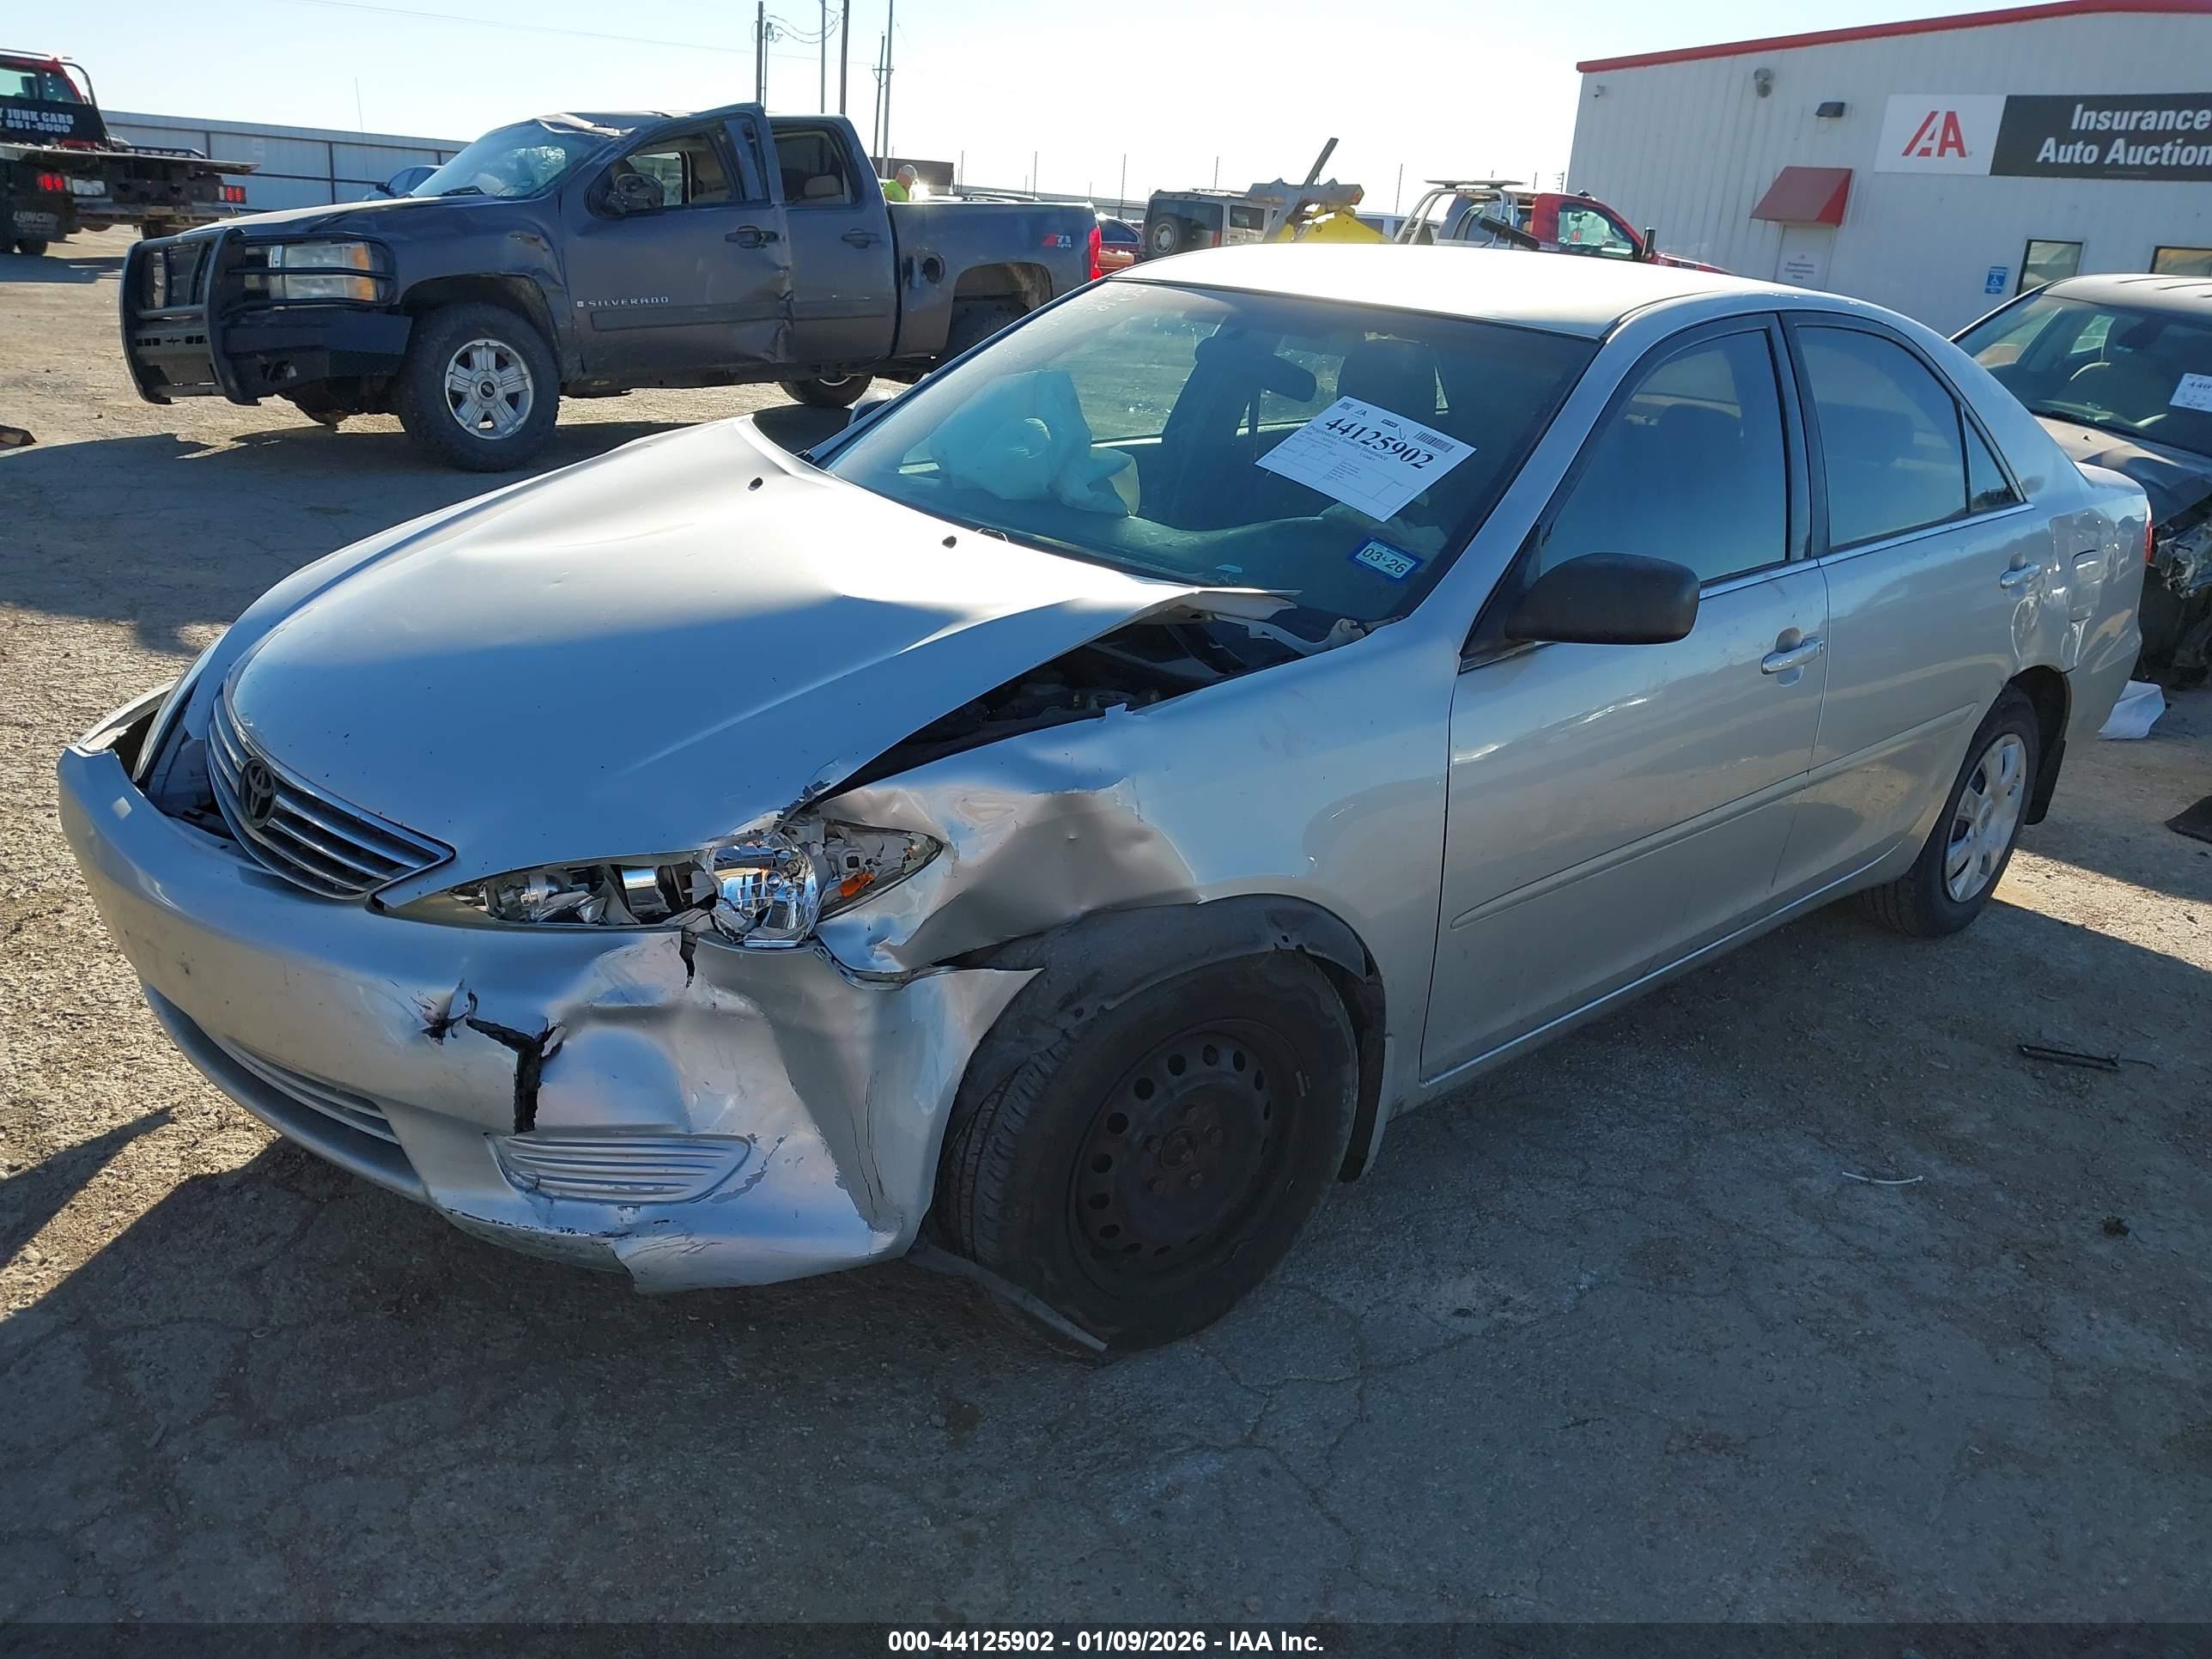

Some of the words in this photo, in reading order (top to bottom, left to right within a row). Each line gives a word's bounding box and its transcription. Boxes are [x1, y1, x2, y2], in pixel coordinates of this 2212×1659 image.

[41, 112, 74, 125] CARS
[2070, 103, 2211, 131] Insurance
[2036, 137, 2100, 165] Auto
[2104, 137, 2212, 167] Auction
[588, 295, 669, 307] SILVERADO
[1325, 417, 1435, 470] 44125902
[1362, 548, 1383, 562] 03
[1384, 558, 1407, 574] 26
